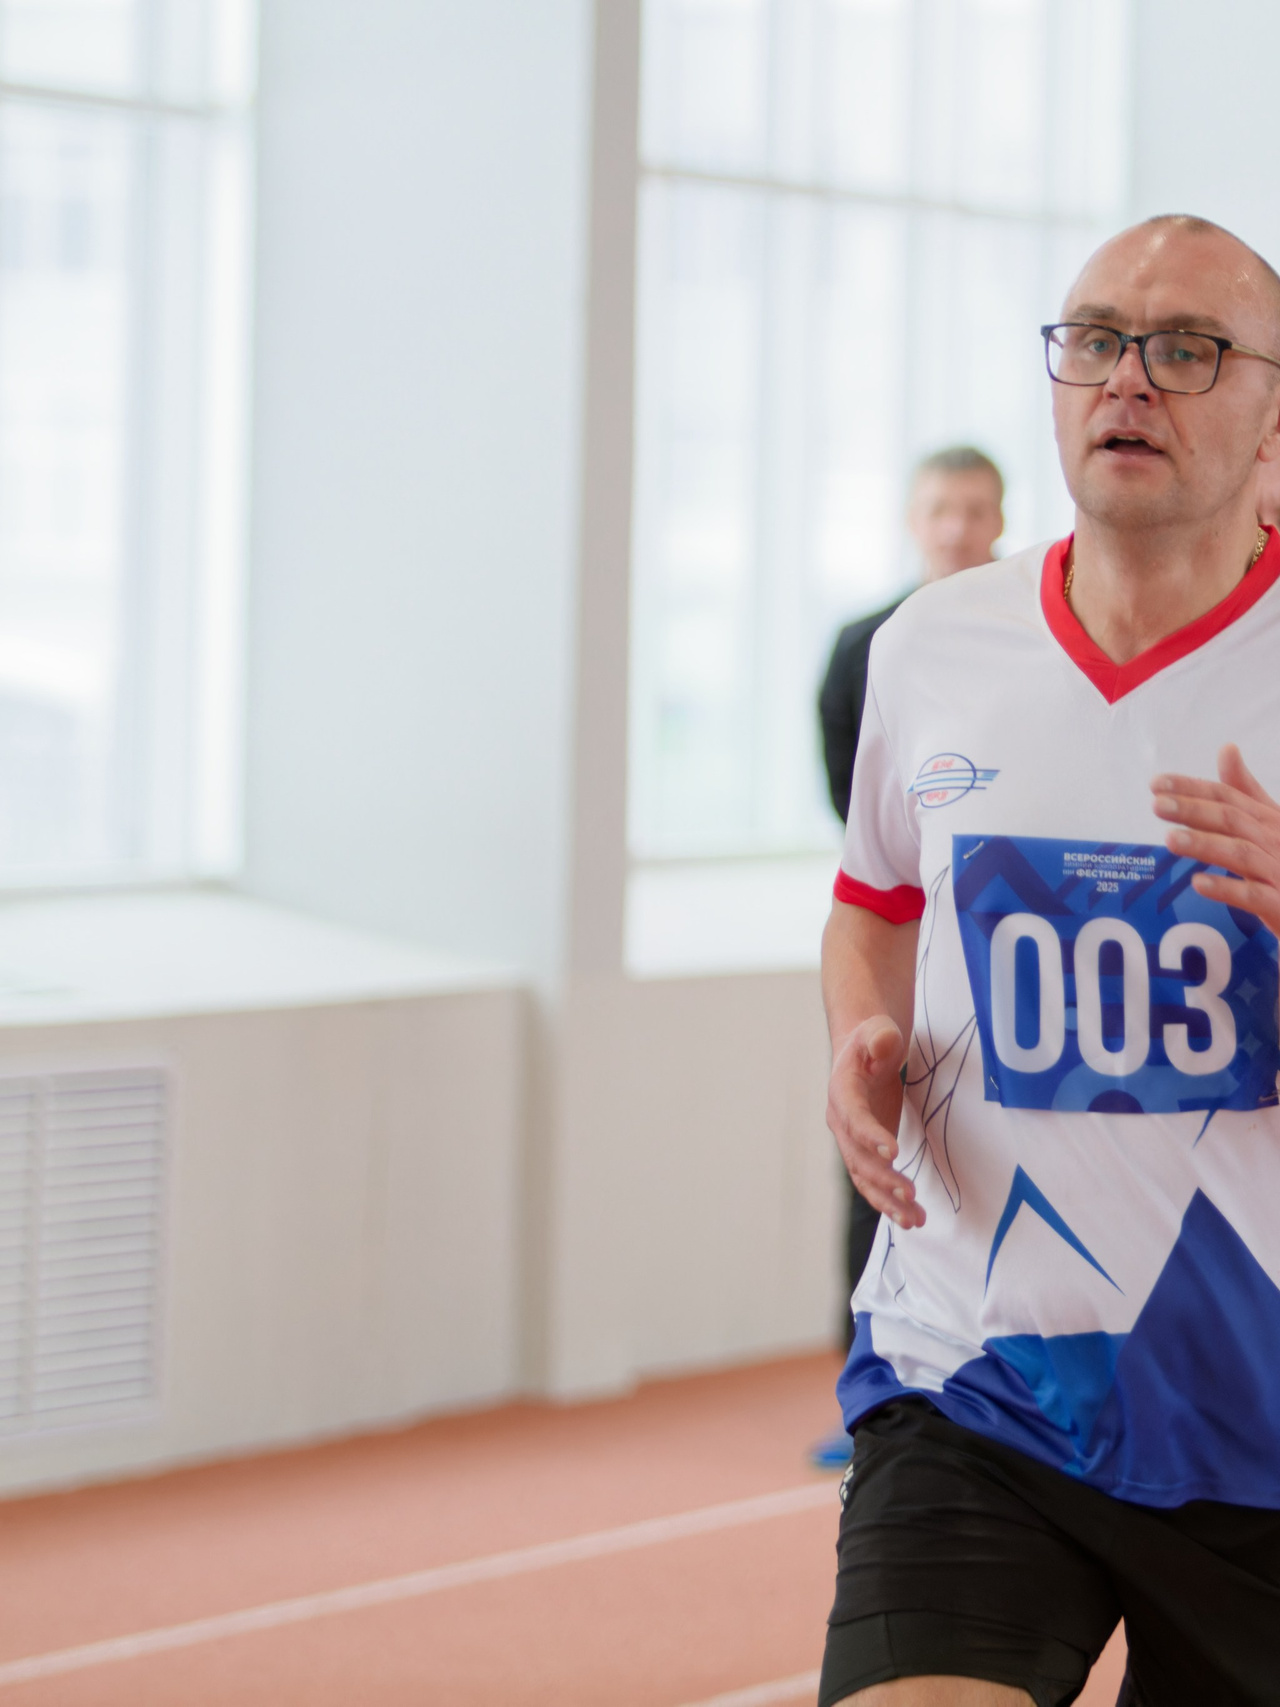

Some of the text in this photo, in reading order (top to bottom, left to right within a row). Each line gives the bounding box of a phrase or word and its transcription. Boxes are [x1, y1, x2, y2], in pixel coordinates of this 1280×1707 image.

[1063, 852, 1156, 867] ВСЕРОССИЙСКИЙ
[1076, 868, 1141, 881] ФЕСТИВАЛЬ
[1096, 881, 1119, 893] 2025
[990, 912, 1237, 1077] 003
